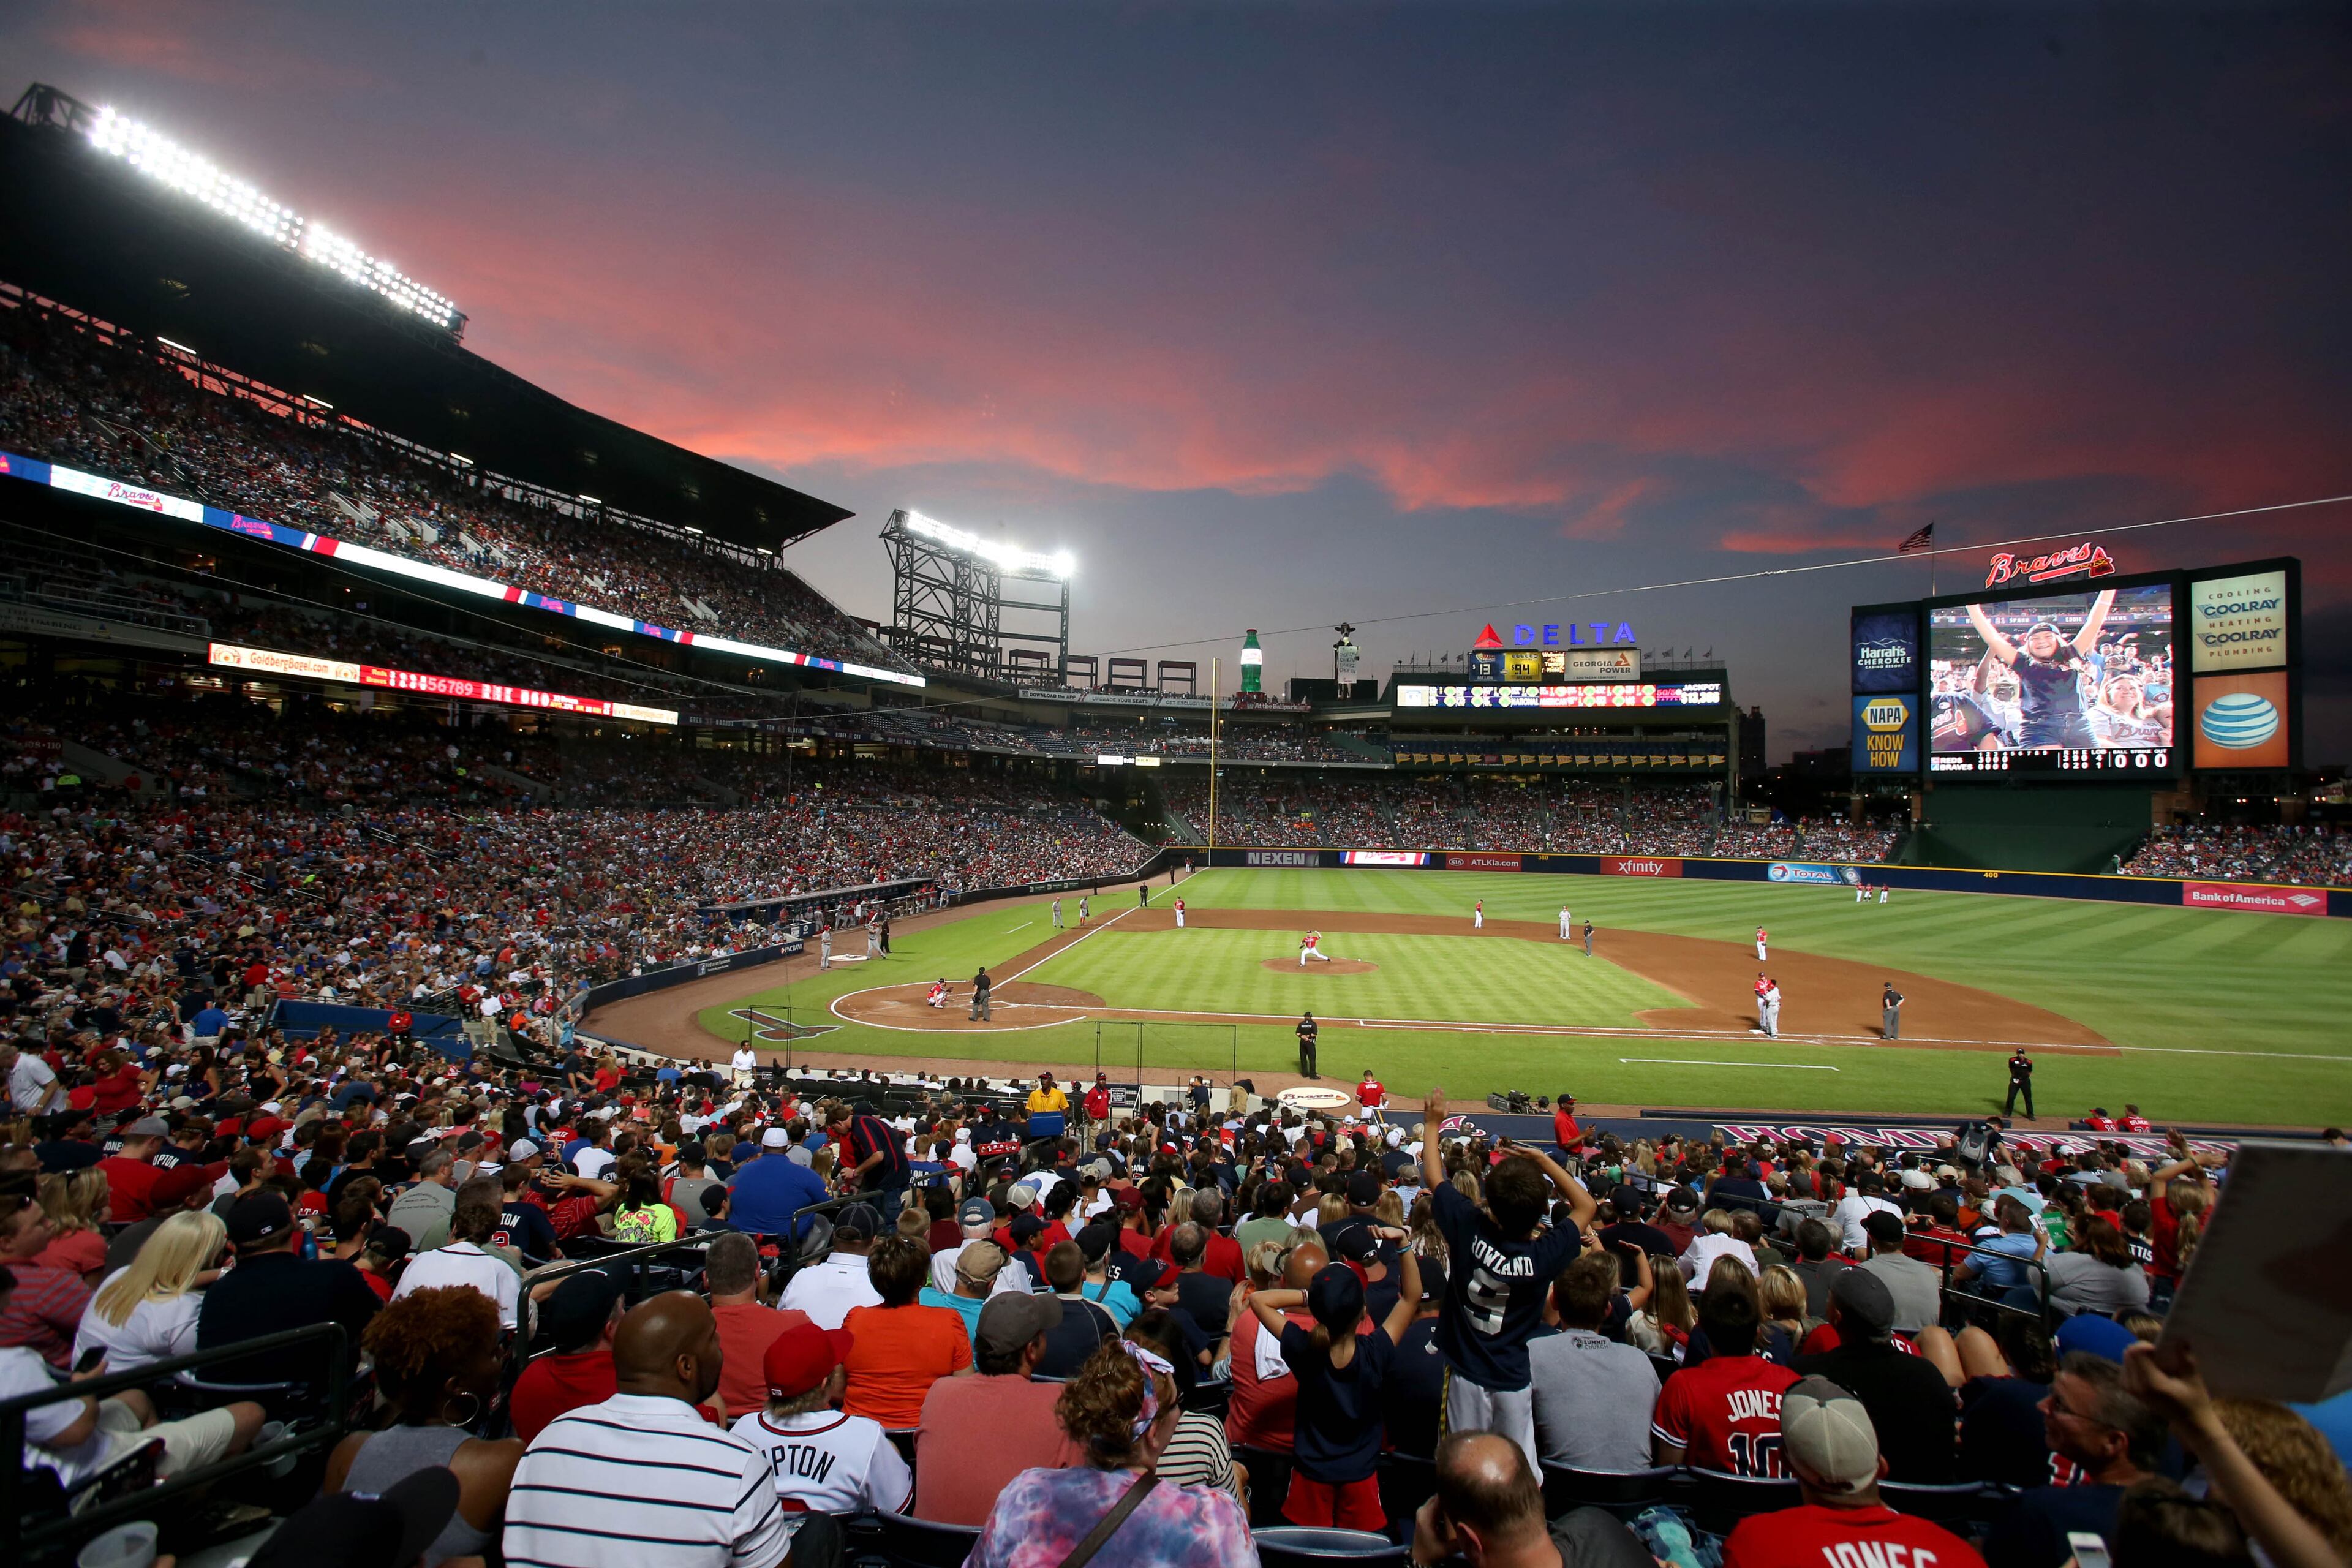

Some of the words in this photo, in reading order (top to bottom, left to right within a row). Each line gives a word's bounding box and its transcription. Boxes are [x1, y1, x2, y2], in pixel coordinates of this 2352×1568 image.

[108, 483, 154, 501] Braves
[1985, 542, 2092, 589] Braves
[2209, 587, 2271, 600] COOLING
[2204, 598, 2280, 617] COOLRAY
[2209, 617, 2272, 629] HEATING
[1514, 622, 1635, 646] DELTA
[2205, 628, 2281, 646] COOLRAY
[2209, 647, 2272, 658] PLUMBING
[250, 652, 329, 674] GoldbergBagel.com
[1480, 663, 1491, 675] 13
[1858, 657, 1911, 666] CHEROKEE
[1870, 708, 1901, 724] NAPA
[1867, 735, 1905, 751] KNOW
[1871, 751, 1900, 767] HOW
[2114, 755, 2126, 768] 0
[2135, 754, 2147, 768] 0
[2154, 754, 2166, 767] 0
[1248, 852, 1305, 865] NEXEN
[1471, 859, 1518, 867] ATLKia.com
[1618, 860, 1663, 875] xfinity
[2193, 892, 2223, 902] Bank
[2225, 892, 2234, 902] of
[2235, 894, 2285, 906] America
[152, 1154, 179, 1169] UPTON
[1472, 1235, 1534, 1277] ROWLAND
